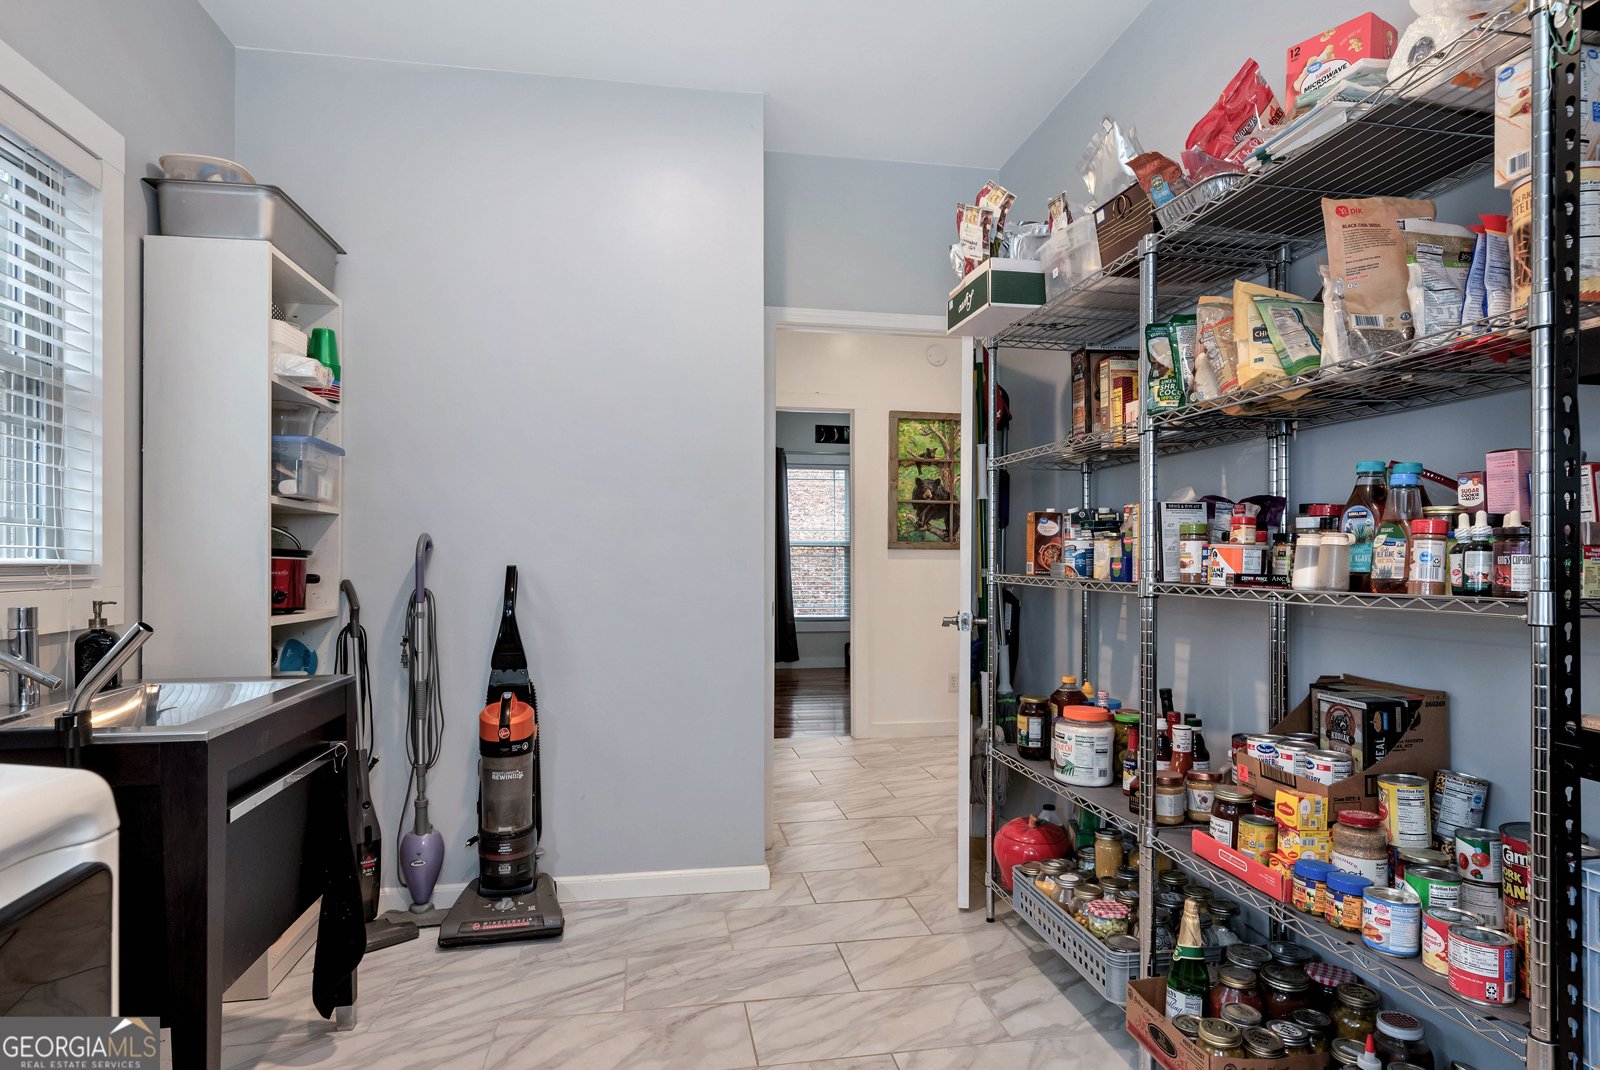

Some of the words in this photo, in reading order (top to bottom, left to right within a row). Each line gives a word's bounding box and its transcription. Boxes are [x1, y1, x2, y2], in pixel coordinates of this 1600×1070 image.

[1290, 46, 1301, 58] 12
[1303, 62, 1348, 93] MICROWAVE
[1268, 106, 1284, 125] FRIED
[1233, 114, 1258, 143] Clancy's
[1254, 330, 1268, 338] CHI
[1331, 730, 1351, 744] KODIAK
